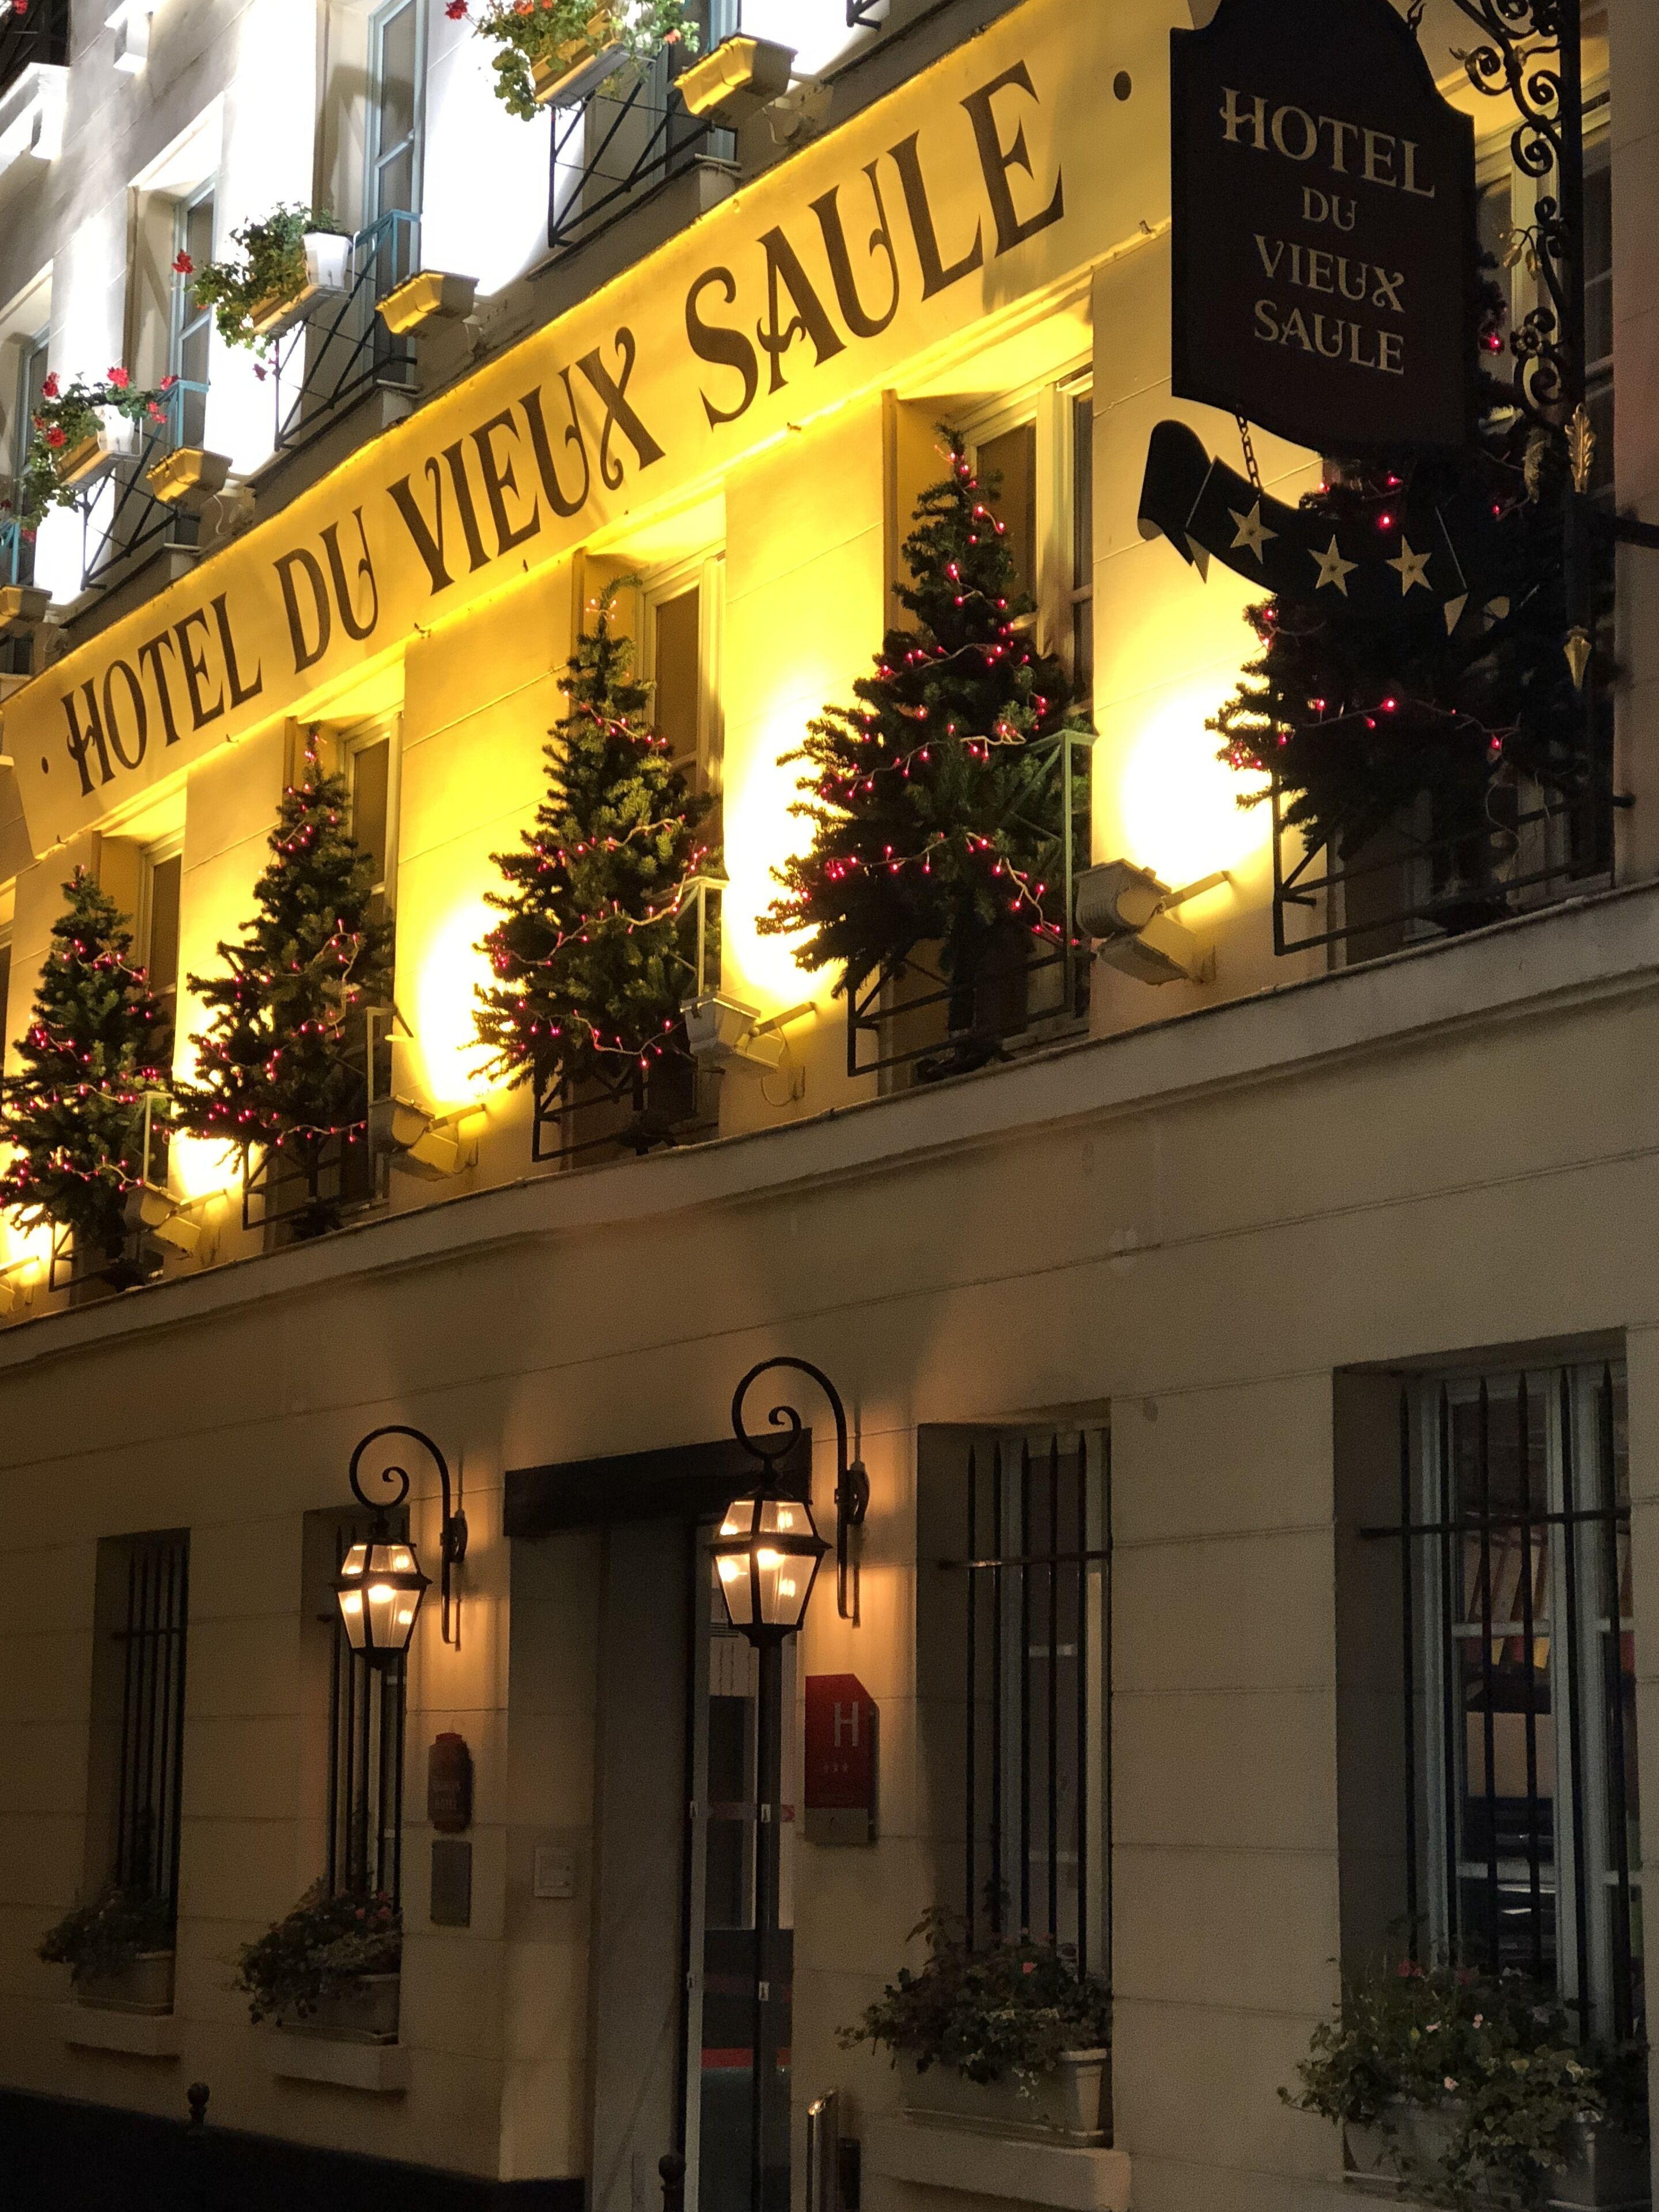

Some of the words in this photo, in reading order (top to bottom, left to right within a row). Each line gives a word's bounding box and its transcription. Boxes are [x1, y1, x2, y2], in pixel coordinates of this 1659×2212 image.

[1219, 86, 1435, 199] HOTEL
[1301, 186, 1357, 232] DU
[1252, 233, 1407, 315] VIEUX
[1253, 299, 1406, 375] SAULE
[60, 592, 263, 797] HOTEL
[272, 505, 378, 674] DU
[386, 326, 666, 596] VIEUX
[684, 59, 1065, 432] SAULE
[834, 1701, 859, 1747] H
